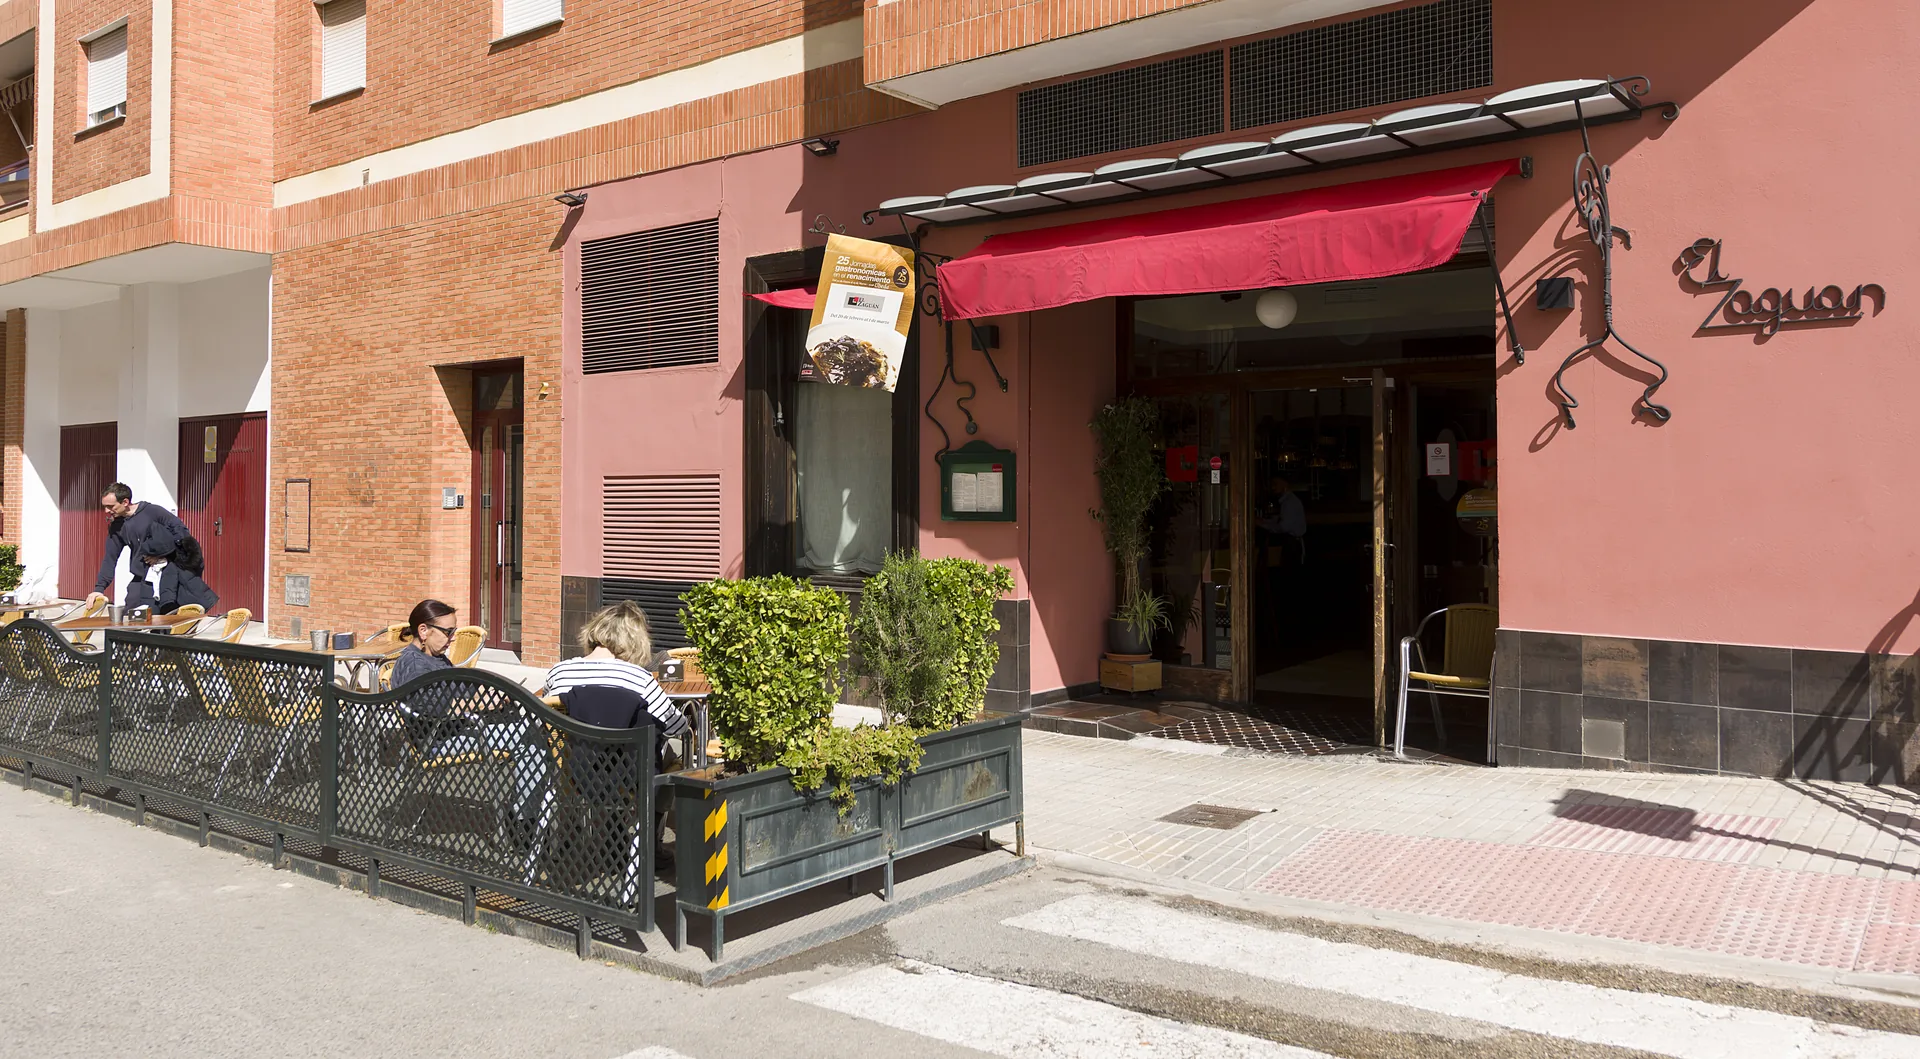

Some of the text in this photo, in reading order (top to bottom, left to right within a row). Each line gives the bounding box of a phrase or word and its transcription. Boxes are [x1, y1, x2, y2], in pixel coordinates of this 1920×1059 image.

[837, 256, 850, 265] 25
[835, 265, 886, 277] gastronómicas
[846, 273, 890, 284] renacimiento
[1700, 278, 1886, 335] Zaguan
